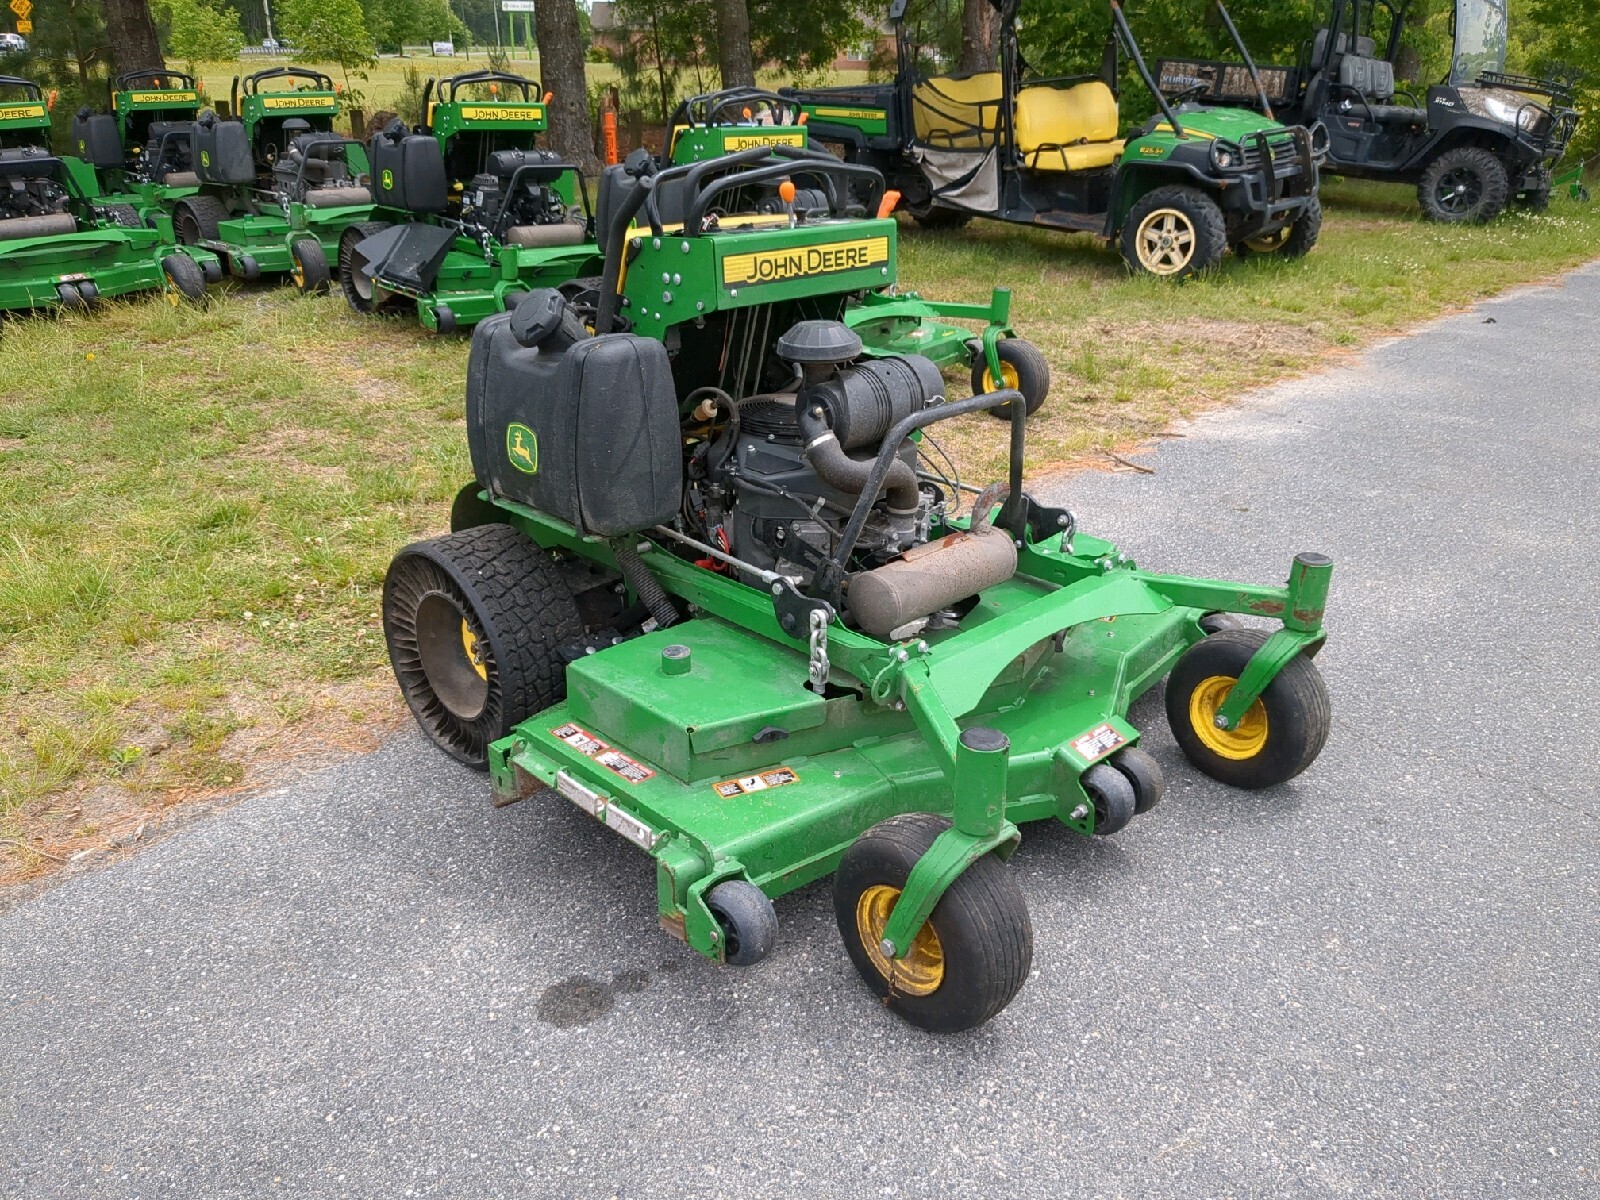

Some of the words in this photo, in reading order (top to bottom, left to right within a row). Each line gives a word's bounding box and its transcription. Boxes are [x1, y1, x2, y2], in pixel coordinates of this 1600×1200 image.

[275, 98, 297, 107] JOHN
[298, 98, 326, 107] DEERE
[472, 109, 498, 119] JOHN
[501, 109, 533, 119] DEERE
[735, 138, 761, 150] JOHN
[746, 255, 803, 280] JOHN
[807, 246, 868, 271] DEERE
